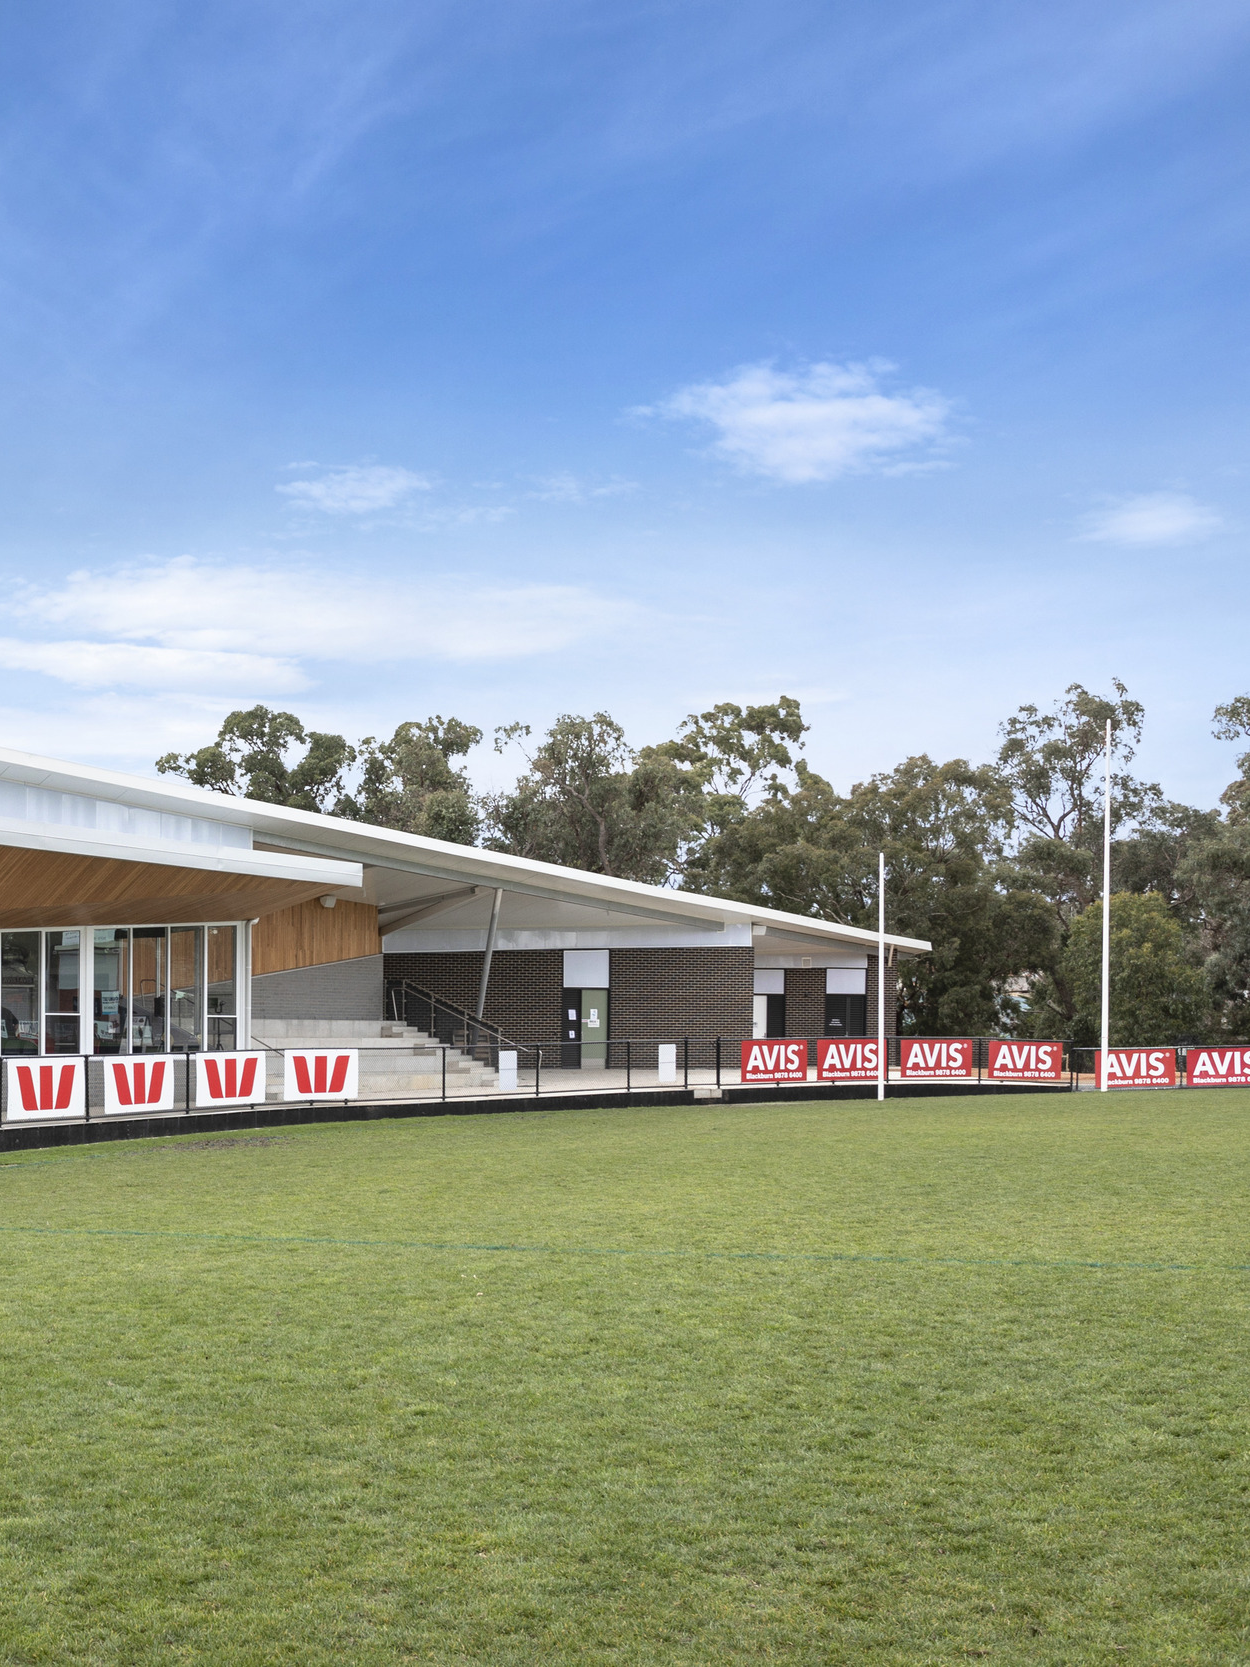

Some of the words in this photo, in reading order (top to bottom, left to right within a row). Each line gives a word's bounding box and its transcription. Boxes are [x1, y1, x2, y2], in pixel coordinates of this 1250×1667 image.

[746, 1044, 800, 1071] AVIS
[822, 1043, 877, 1069] AVIS
[906, 1042, 963, 1068] AVIS
[993, 1044, 1053, 1070] AVIS
[1107, 1052, 1165, 1077] AVIS
[746, 1072, 773, 1080] Blackburn
[774, 1071, 788, 1079] 9878
[789, 1071, 803, 1079] 6400
[822, 1070, 849, 1078] Blackburn
[850, 1070, 865, 1078] 9878
